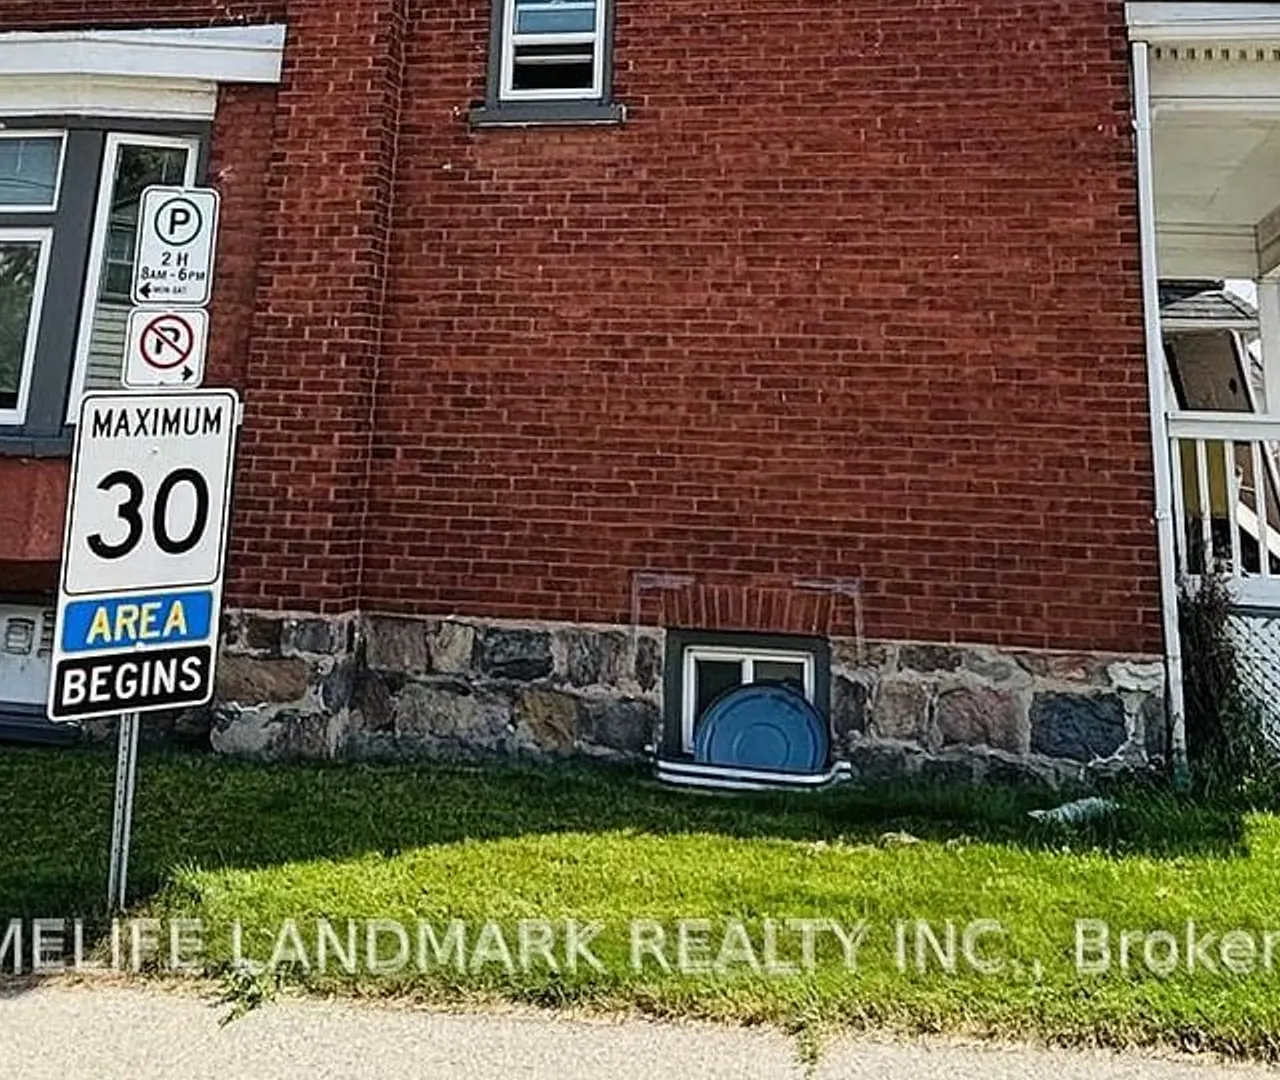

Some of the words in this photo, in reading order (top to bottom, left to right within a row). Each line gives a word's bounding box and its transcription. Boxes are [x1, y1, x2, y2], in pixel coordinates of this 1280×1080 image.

[169, 208, 191, 235] P
[161, 251, 172, 266] 2
[176, 251, 189, 267] H
[92, 406, 223, 439] MAXIMUM
[86, 468, 209, 560] 30
[86, 600, 187, 645] AREA
[61, 655, 202, 707] BEGINS
